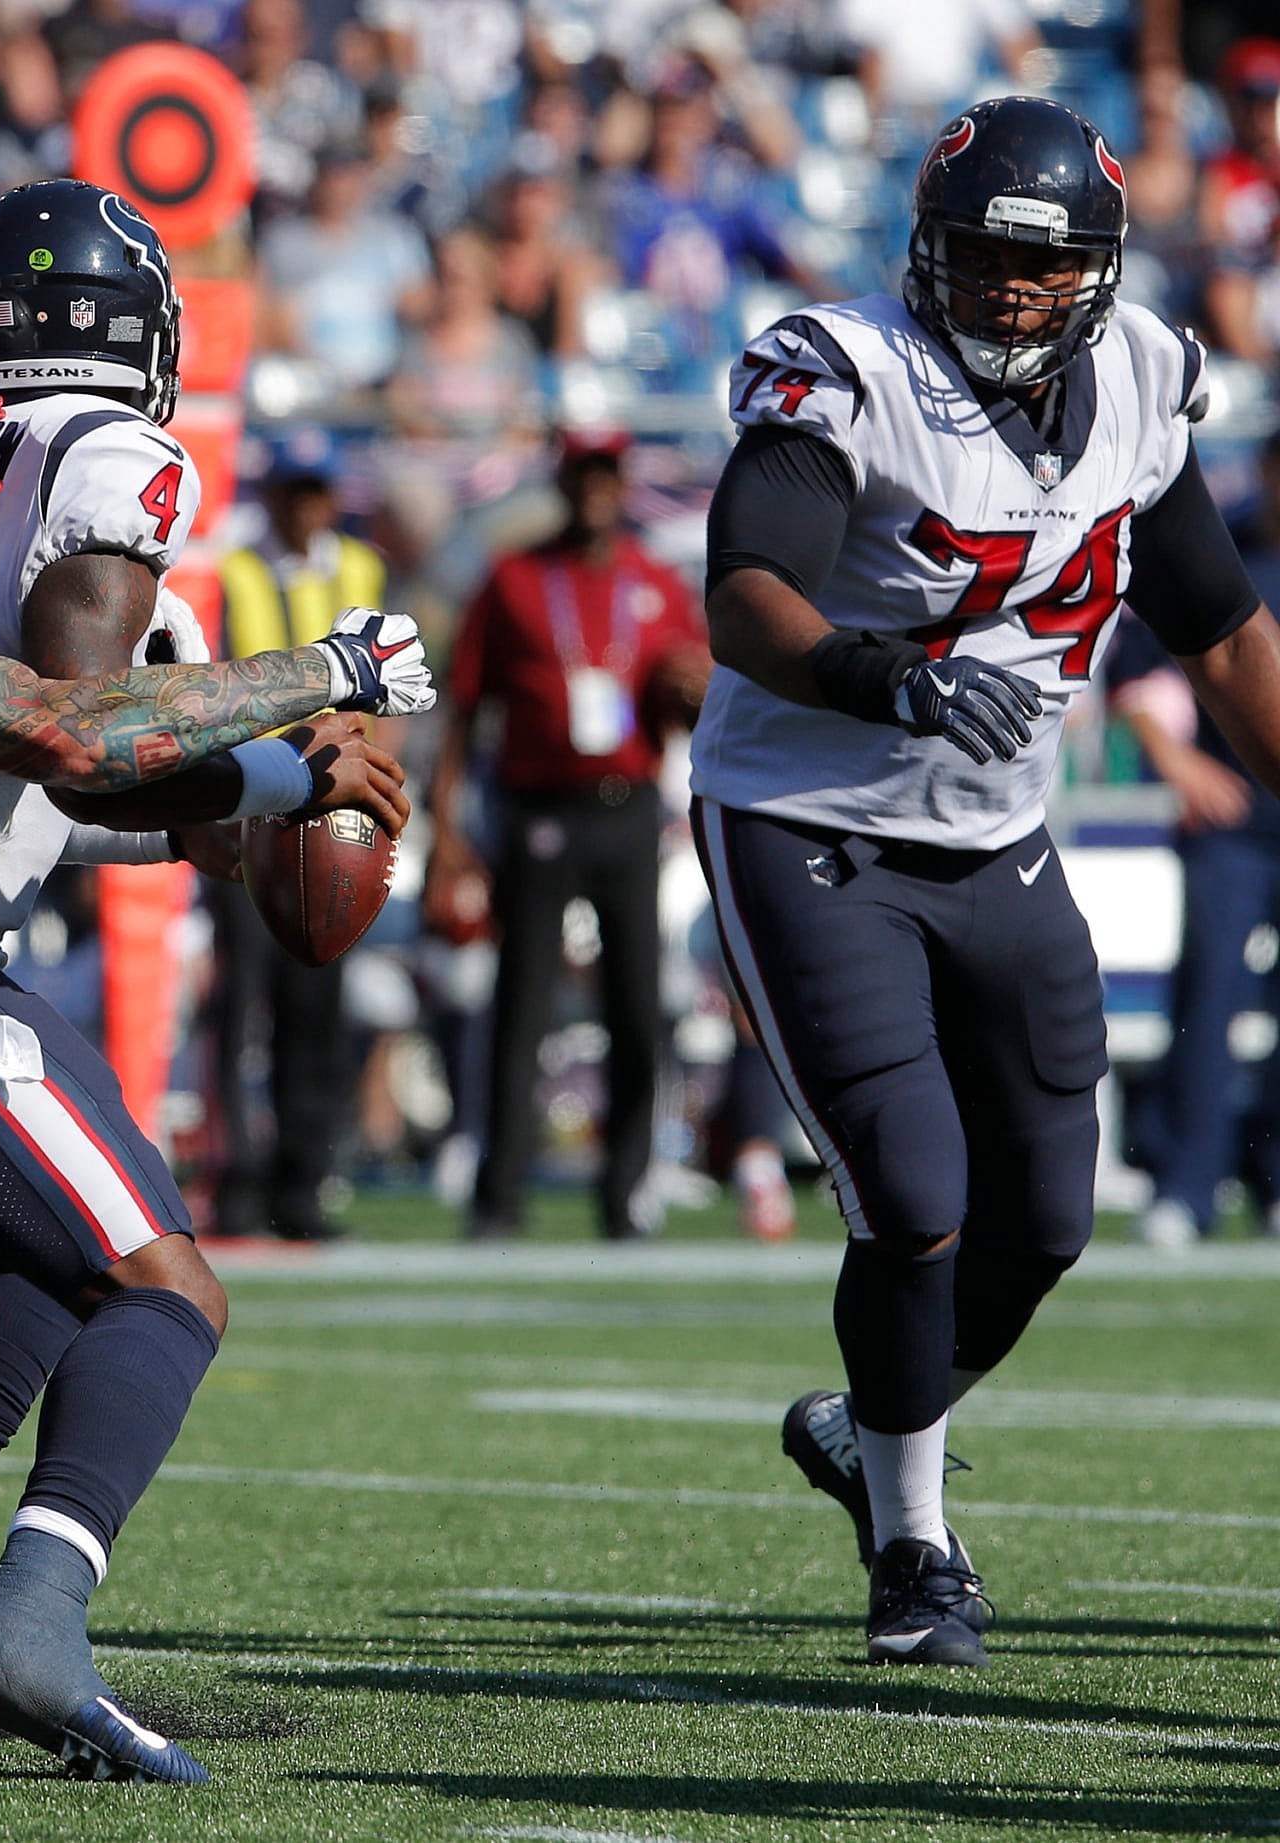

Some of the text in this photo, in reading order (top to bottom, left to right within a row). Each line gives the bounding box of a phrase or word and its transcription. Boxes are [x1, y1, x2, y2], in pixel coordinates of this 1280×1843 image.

[74, 312, 93, 326] NFL
[734, 350, 823, 418] 74
[138, 461, 185, 545] 4
[1003, 509, 1080, 521] TEXANS
[907, 498, 1135, 682] 74
